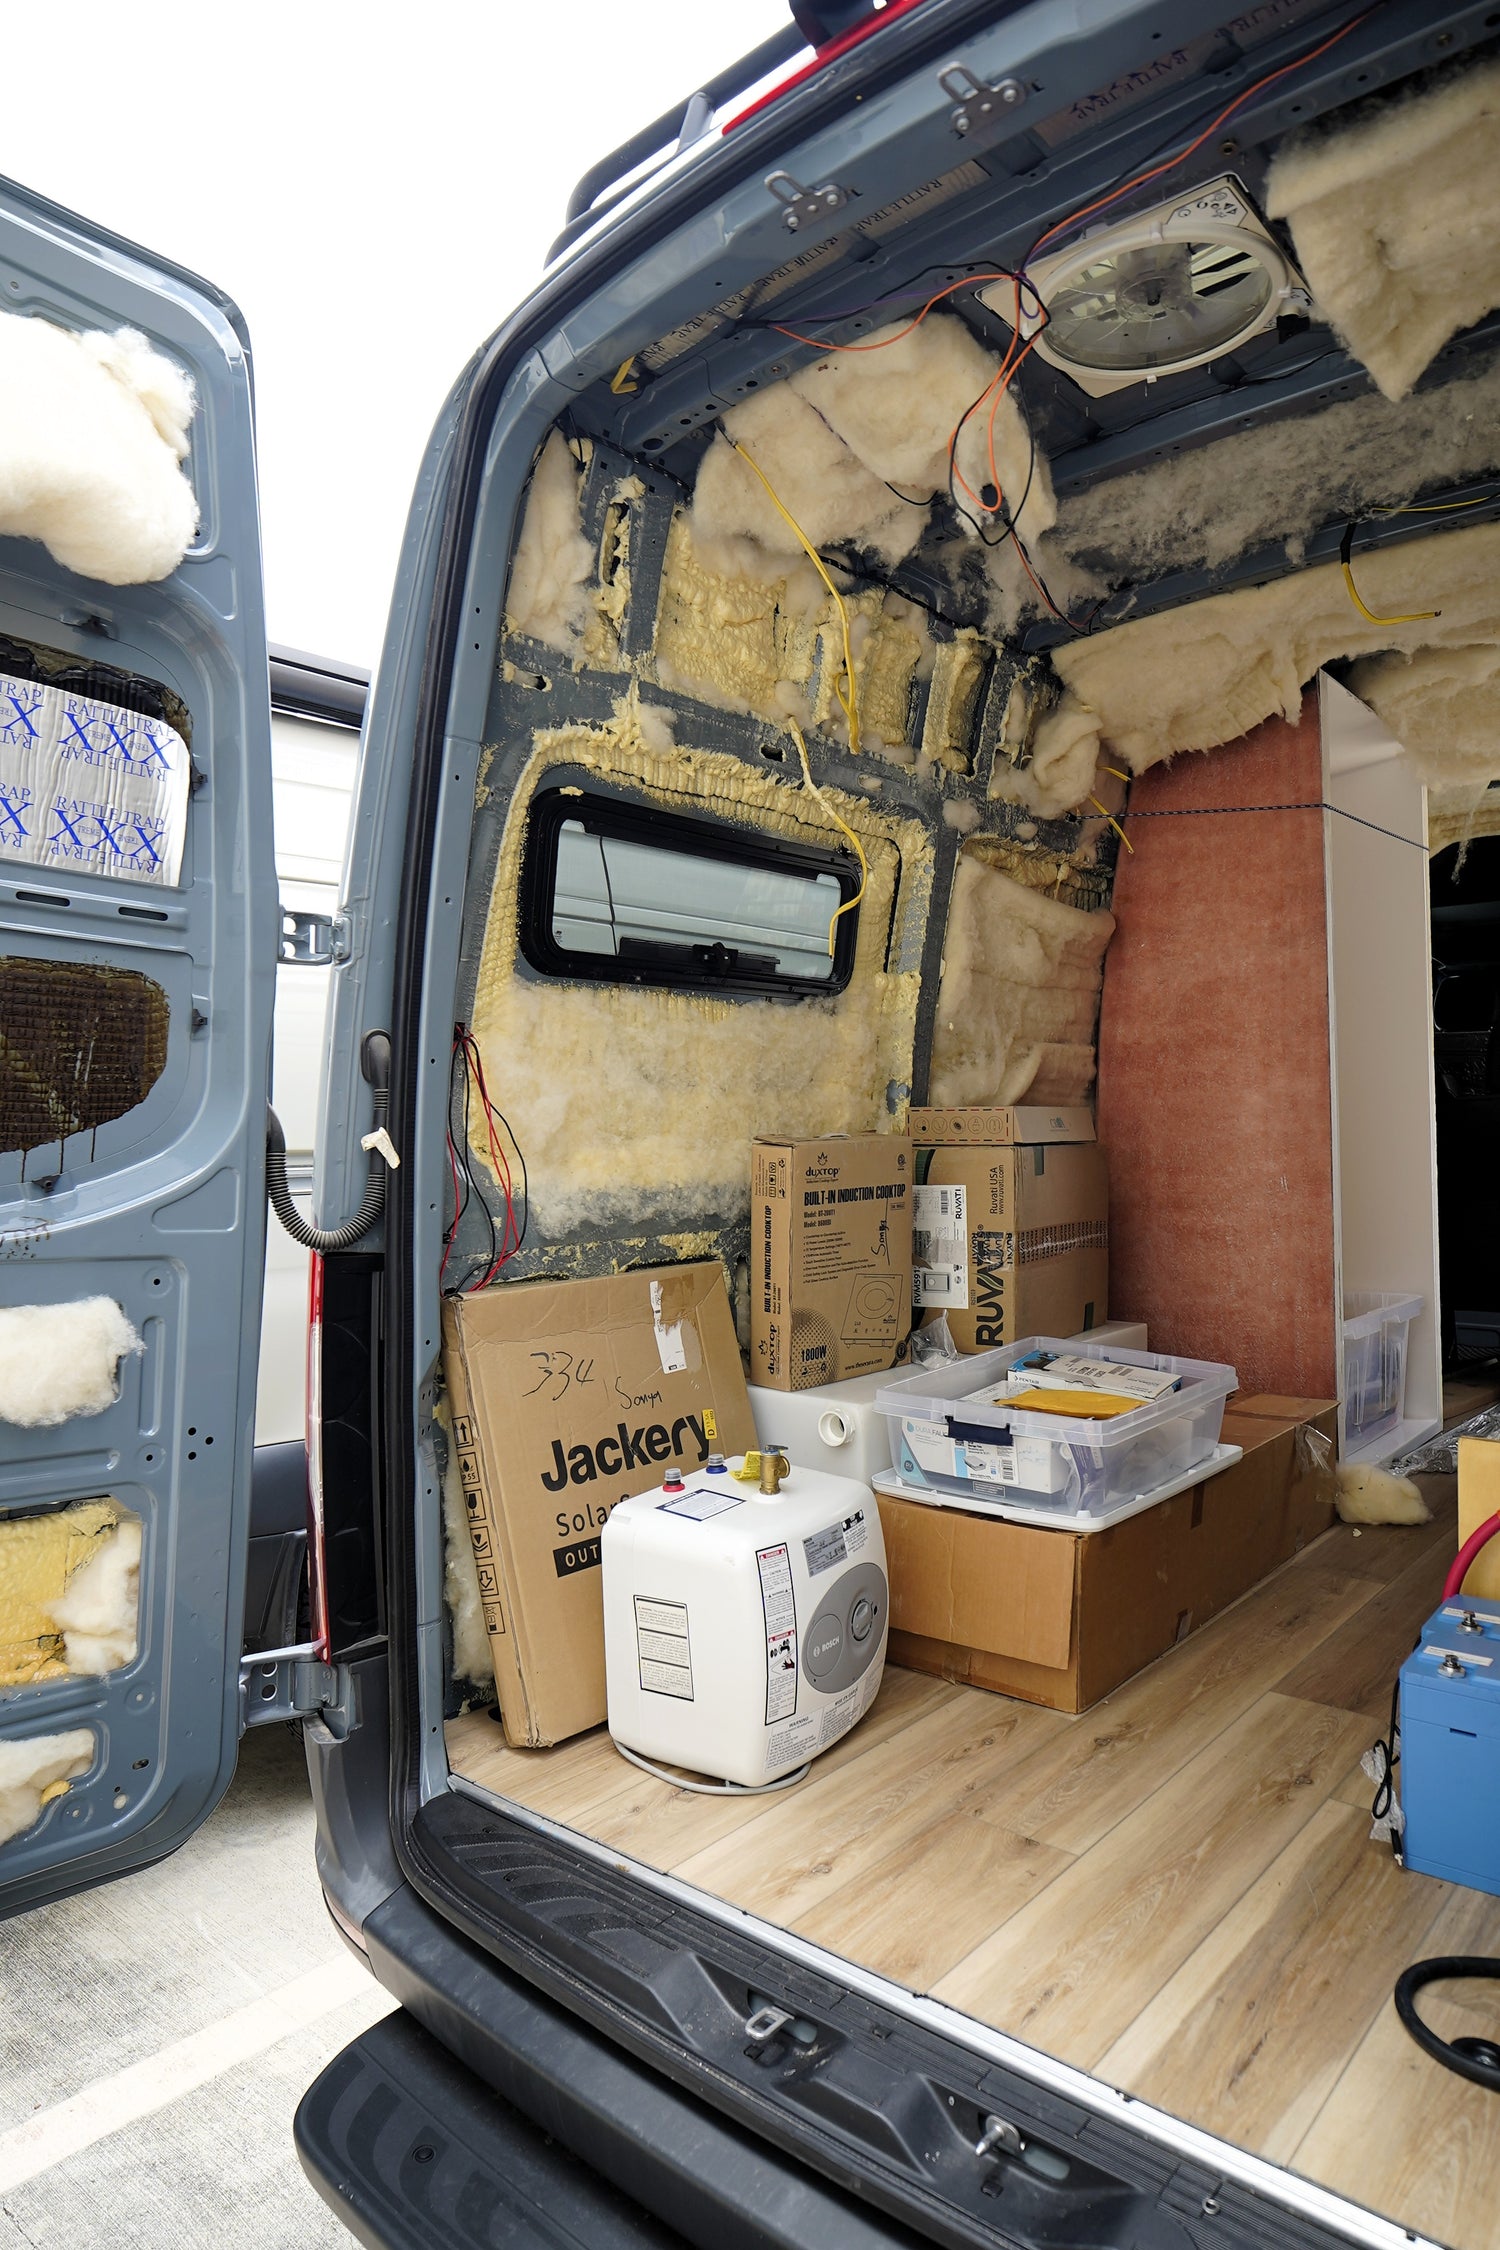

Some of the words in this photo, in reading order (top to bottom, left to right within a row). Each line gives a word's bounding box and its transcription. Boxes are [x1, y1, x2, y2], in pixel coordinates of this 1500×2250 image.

[894, 179, 942, 212] RATTLE
[857, 209, 892, 232] TRAP
[68, 699, 129, 726] RATTLE
[135, 715, 175, 737] TRAP
[61, 745, 103, 766] TRAP
[108, 756, 168, 782] RATTLE
[56, 796, 118, 820] RATTLE
[124, 811, 165, 829] TRAP
[51, 843, 93, 862] TRAP
[98, 850, 157, 874] RATTLE
[990, 1167, 998, 1185] USA
[804, 1190, 836, 1206] BUILT-IN
[838, 1185, 874, 1203] INDUCTION
[876, 1184, 906, 1199] COOKTOP
[990, 1187, 998, 1214] Ruvati
[764, 1205, 772, 1240] COOKTOP
[764, 1282, 772, 1313] BUILT-IN
[976, 1231, 1005, 1347] RUVATI
[801, 1345, 827, 1362] 1800W
[540, 1414, 711, 1492] Jackery
[821, 1636, 840, 1652] BOSCH
